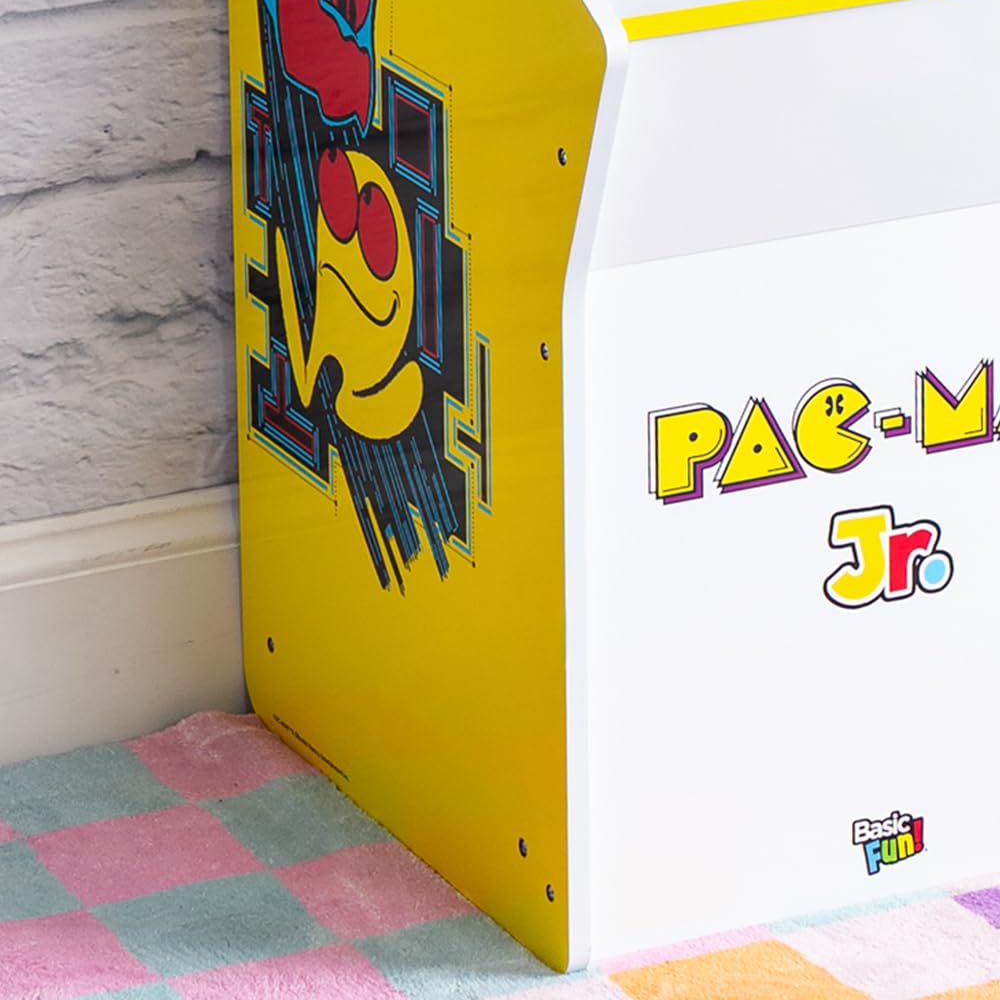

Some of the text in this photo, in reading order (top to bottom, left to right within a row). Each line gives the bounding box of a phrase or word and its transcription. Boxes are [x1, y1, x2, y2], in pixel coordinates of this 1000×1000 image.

[823, 505, 954, 609] Jr.
[852, 810, 912, 845] Basic
[863, 816, 924, 875] Fun!
